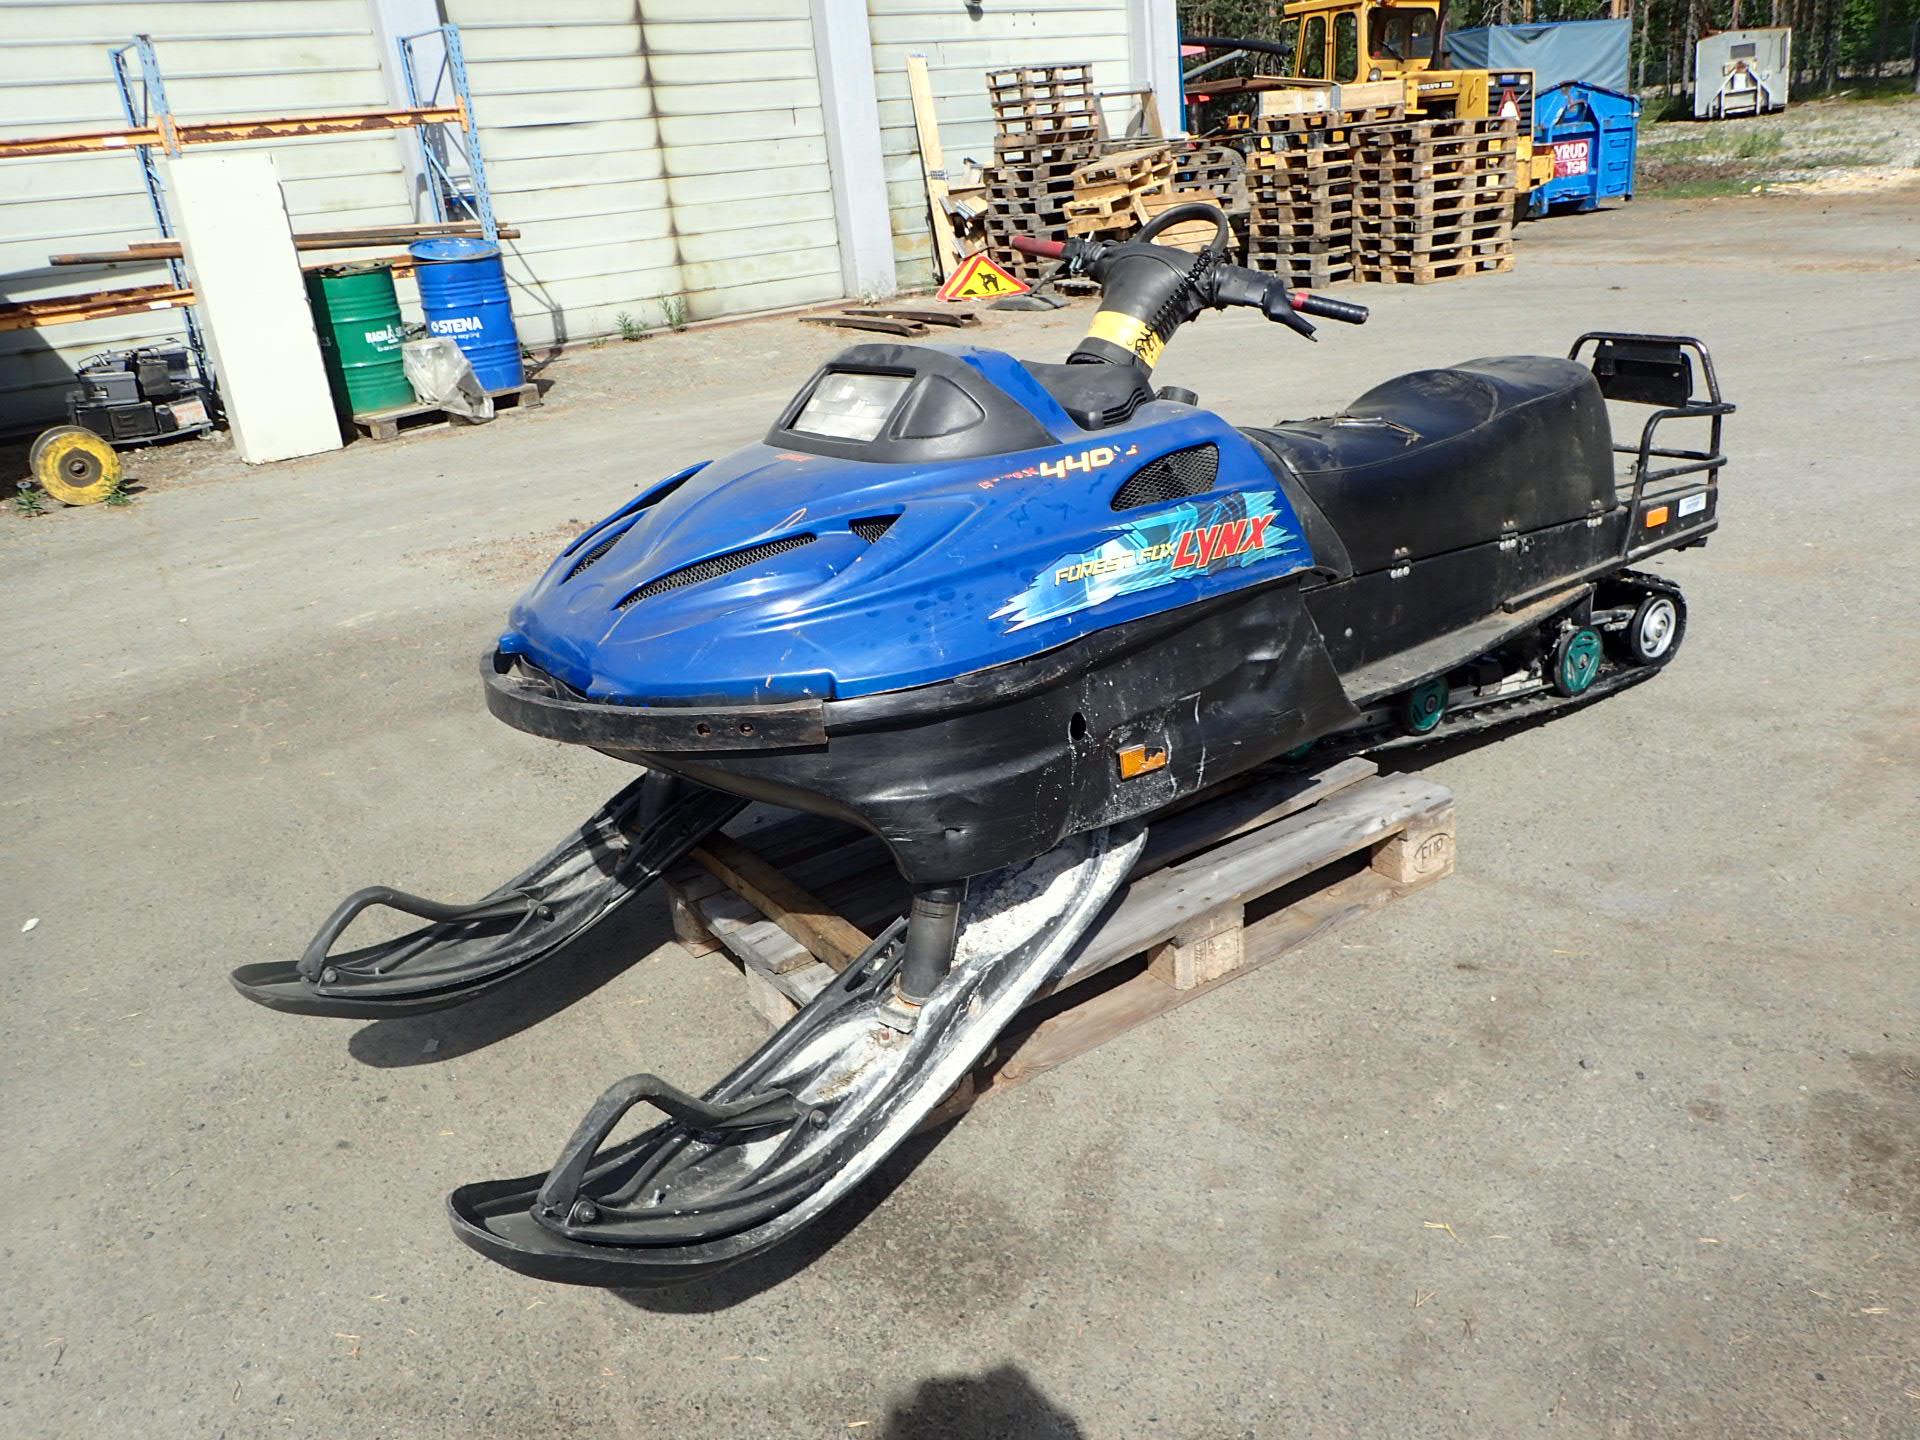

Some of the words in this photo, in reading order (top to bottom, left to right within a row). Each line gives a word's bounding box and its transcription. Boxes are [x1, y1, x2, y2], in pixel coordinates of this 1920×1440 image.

[1553, 142, 1588, 160] YRUD
[438, 316, 483, 334] STENA
[1040, 447, 1114, 478] 440
[1171, 512, 1276, 570] LYNX
[1055, 552, 1136, 586] FOREST
[1139, 541, 1178, 565] FOX
